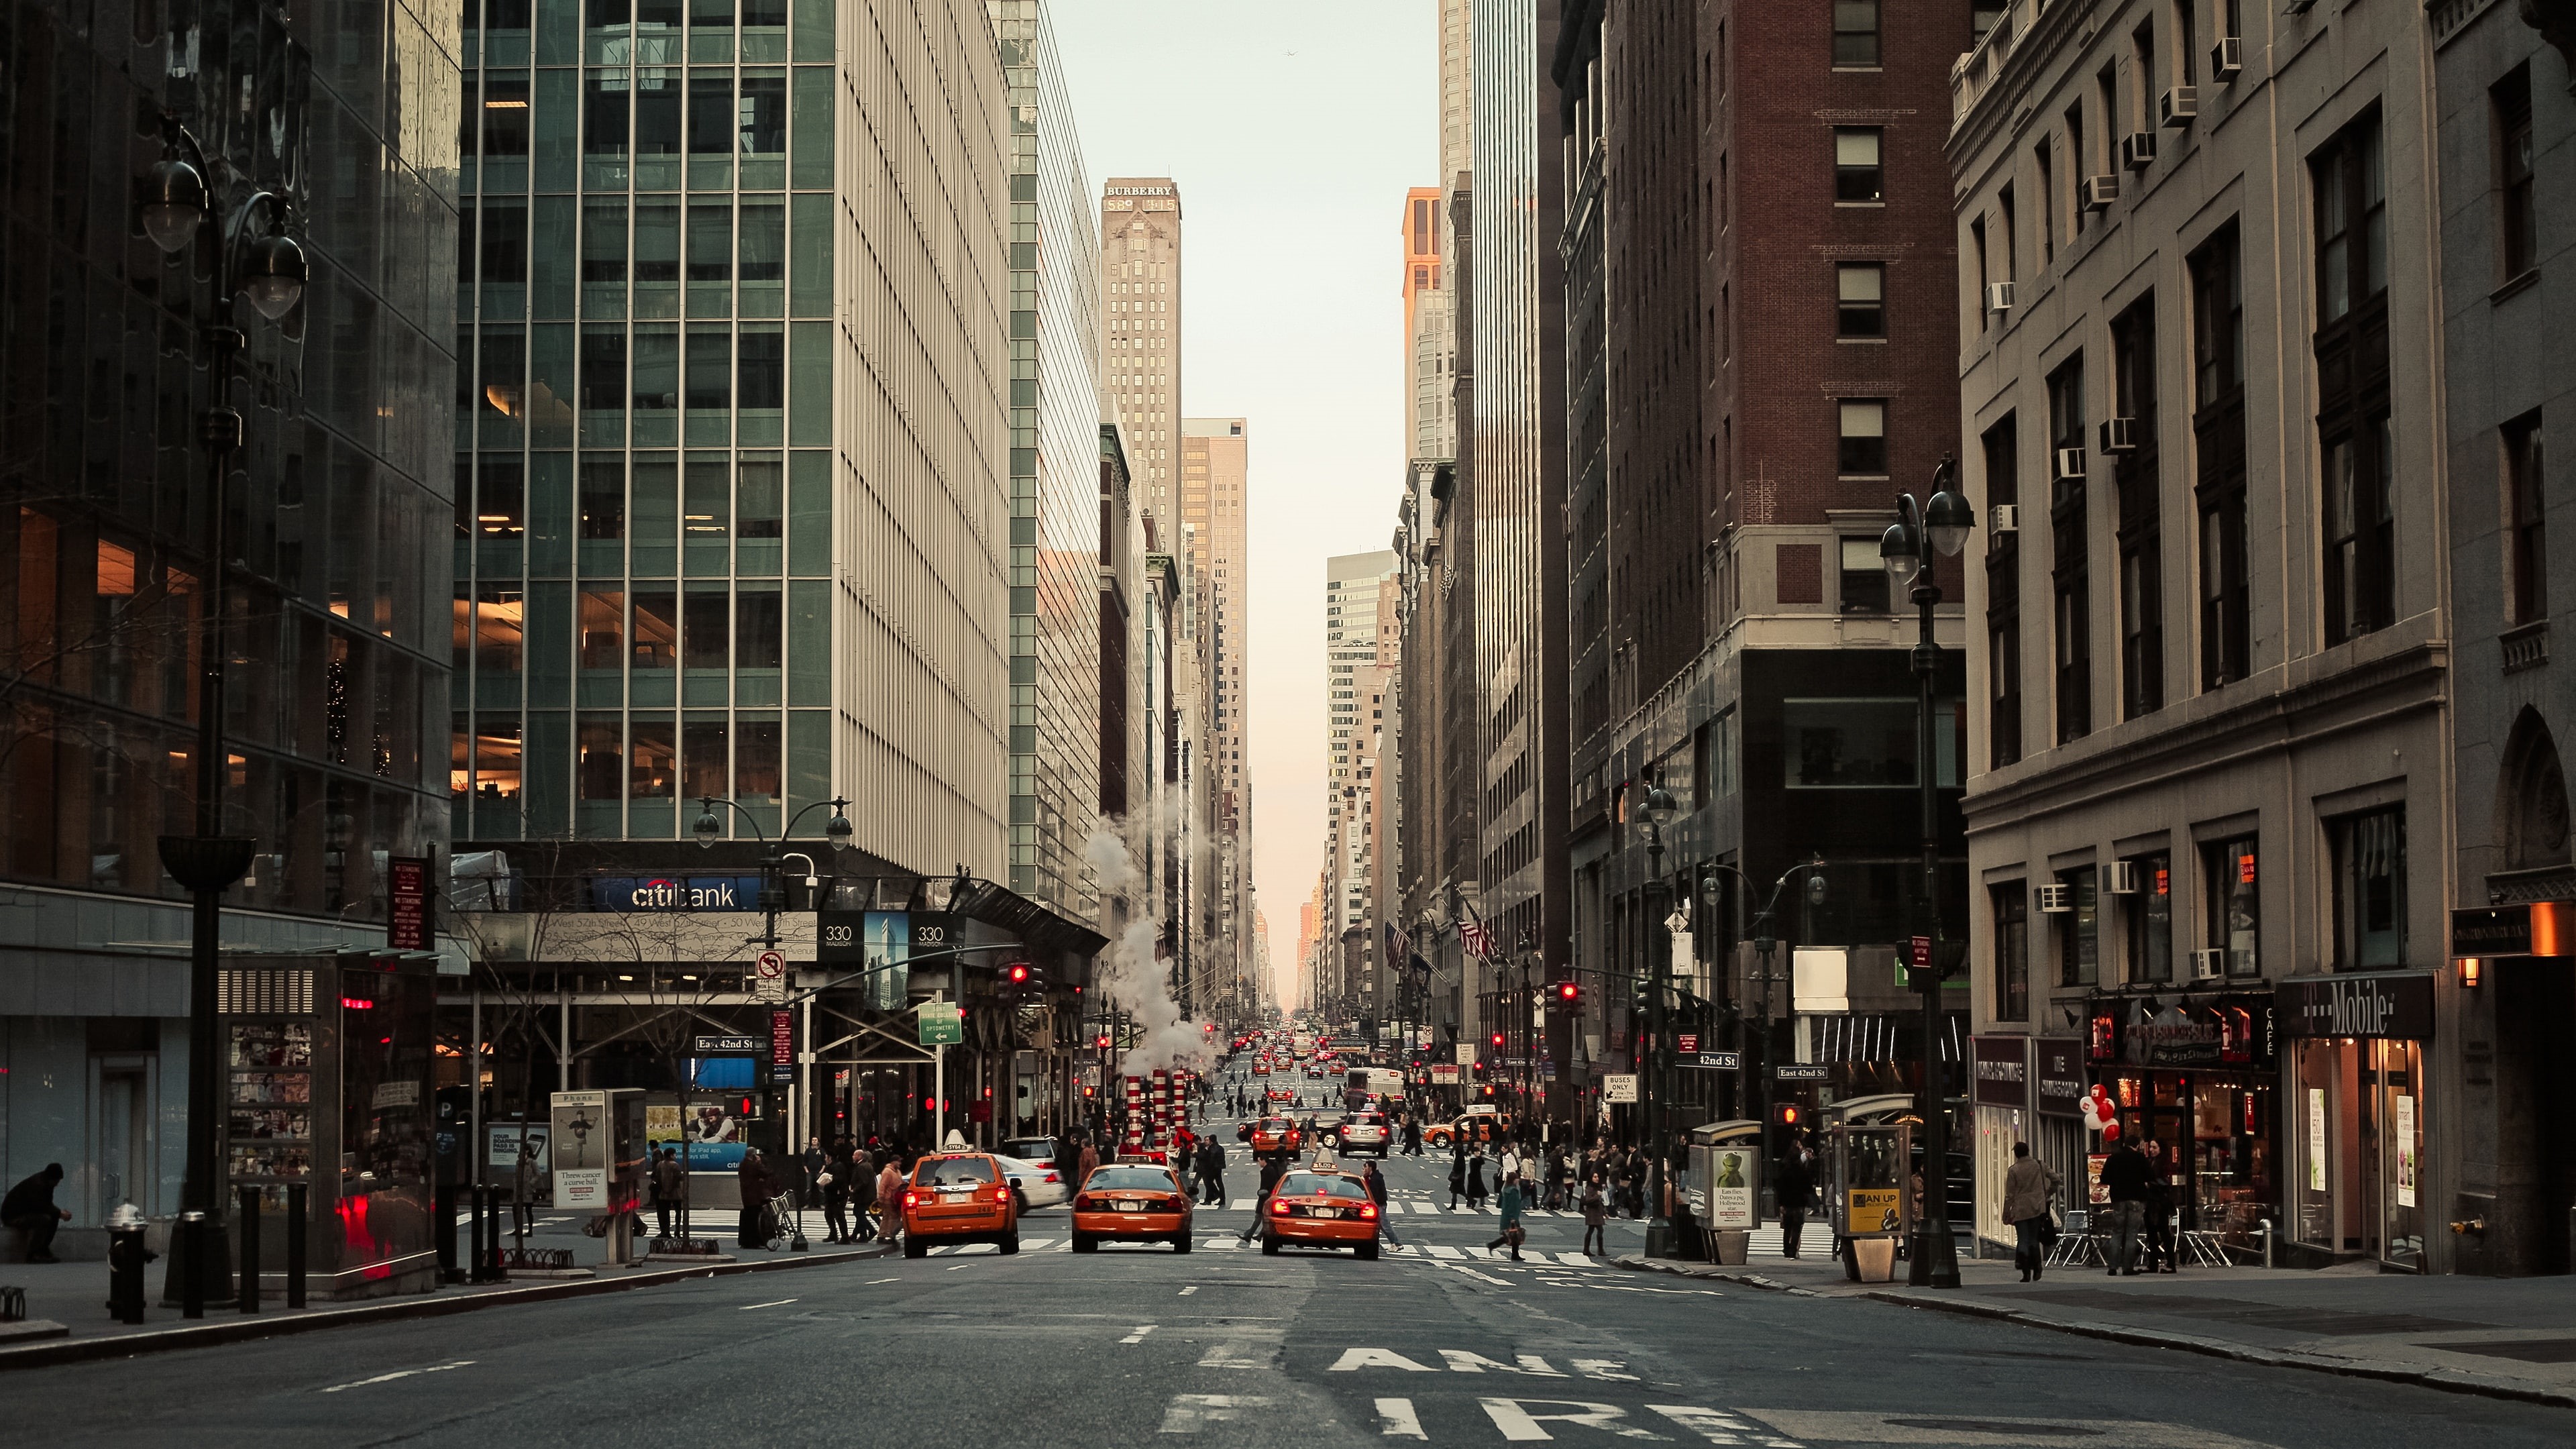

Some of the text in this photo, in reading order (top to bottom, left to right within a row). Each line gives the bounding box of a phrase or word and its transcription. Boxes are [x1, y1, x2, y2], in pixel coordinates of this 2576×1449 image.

[1107, 187, 1172, 195] BURBERRY
[632, 881, 734, 907] citibank
[731, 918, 743, 927] 50
[745, 918, 765, 927] Wes
[826, 926, 851, 941] 330
[918, 926, 943, 941] 330
[720, 1040, 741, 1048] 42nd
[743, 1040, 753, 1048] St
[1700, 1056, 1735, 1066] 42nd St
[441, 1102, 451, 1116] P
[436, 1132, 442, 1140] P
